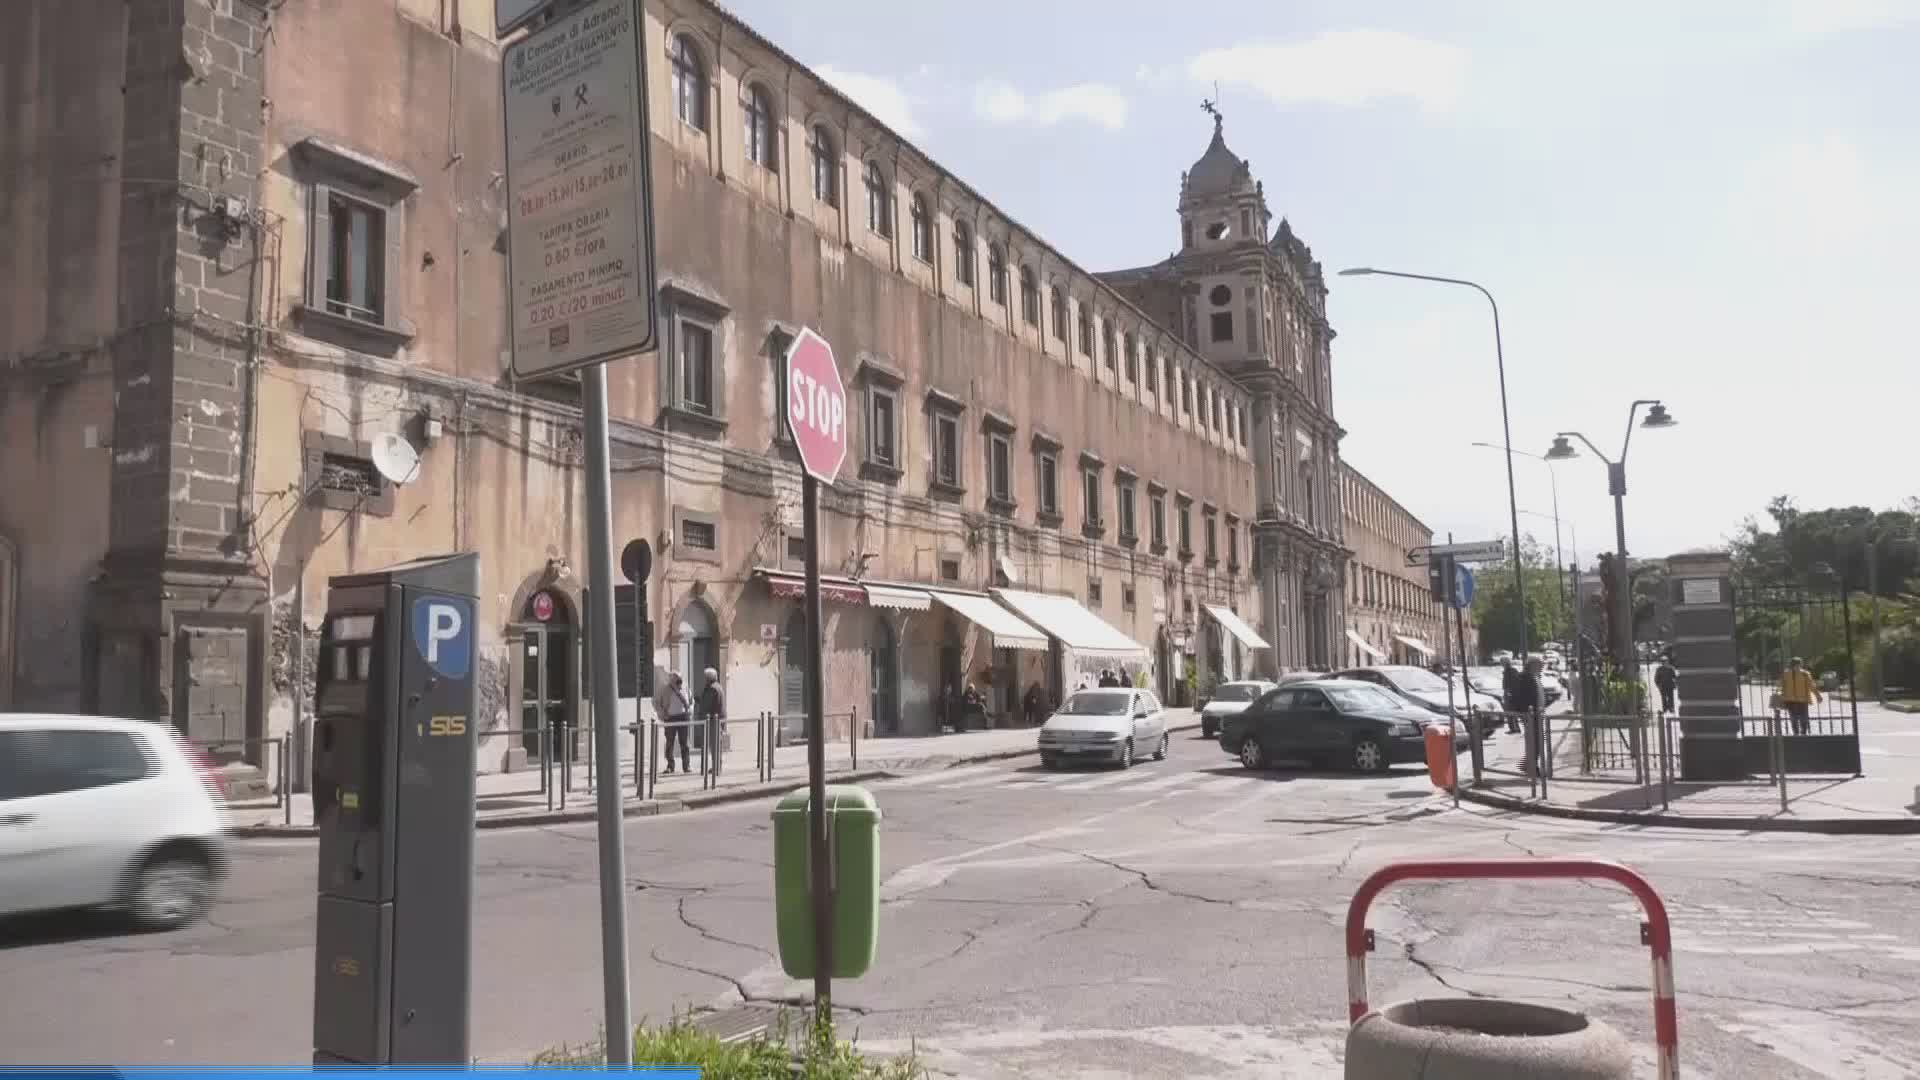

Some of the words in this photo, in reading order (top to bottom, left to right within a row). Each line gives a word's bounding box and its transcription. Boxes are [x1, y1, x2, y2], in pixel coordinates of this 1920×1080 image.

[527, 33, 566, 60] Comune
[570, 23, 579, 39] di
[583, 5, 620, 30] Adrano
[539, 222, 573, 241] TARIFFA
[532, 271, 585, 297] PAGAMENTO
[588, 258, 623, 280] MINIMO
[792, 367, 843, 443] STOP
[428, 604, 461, 662] P
